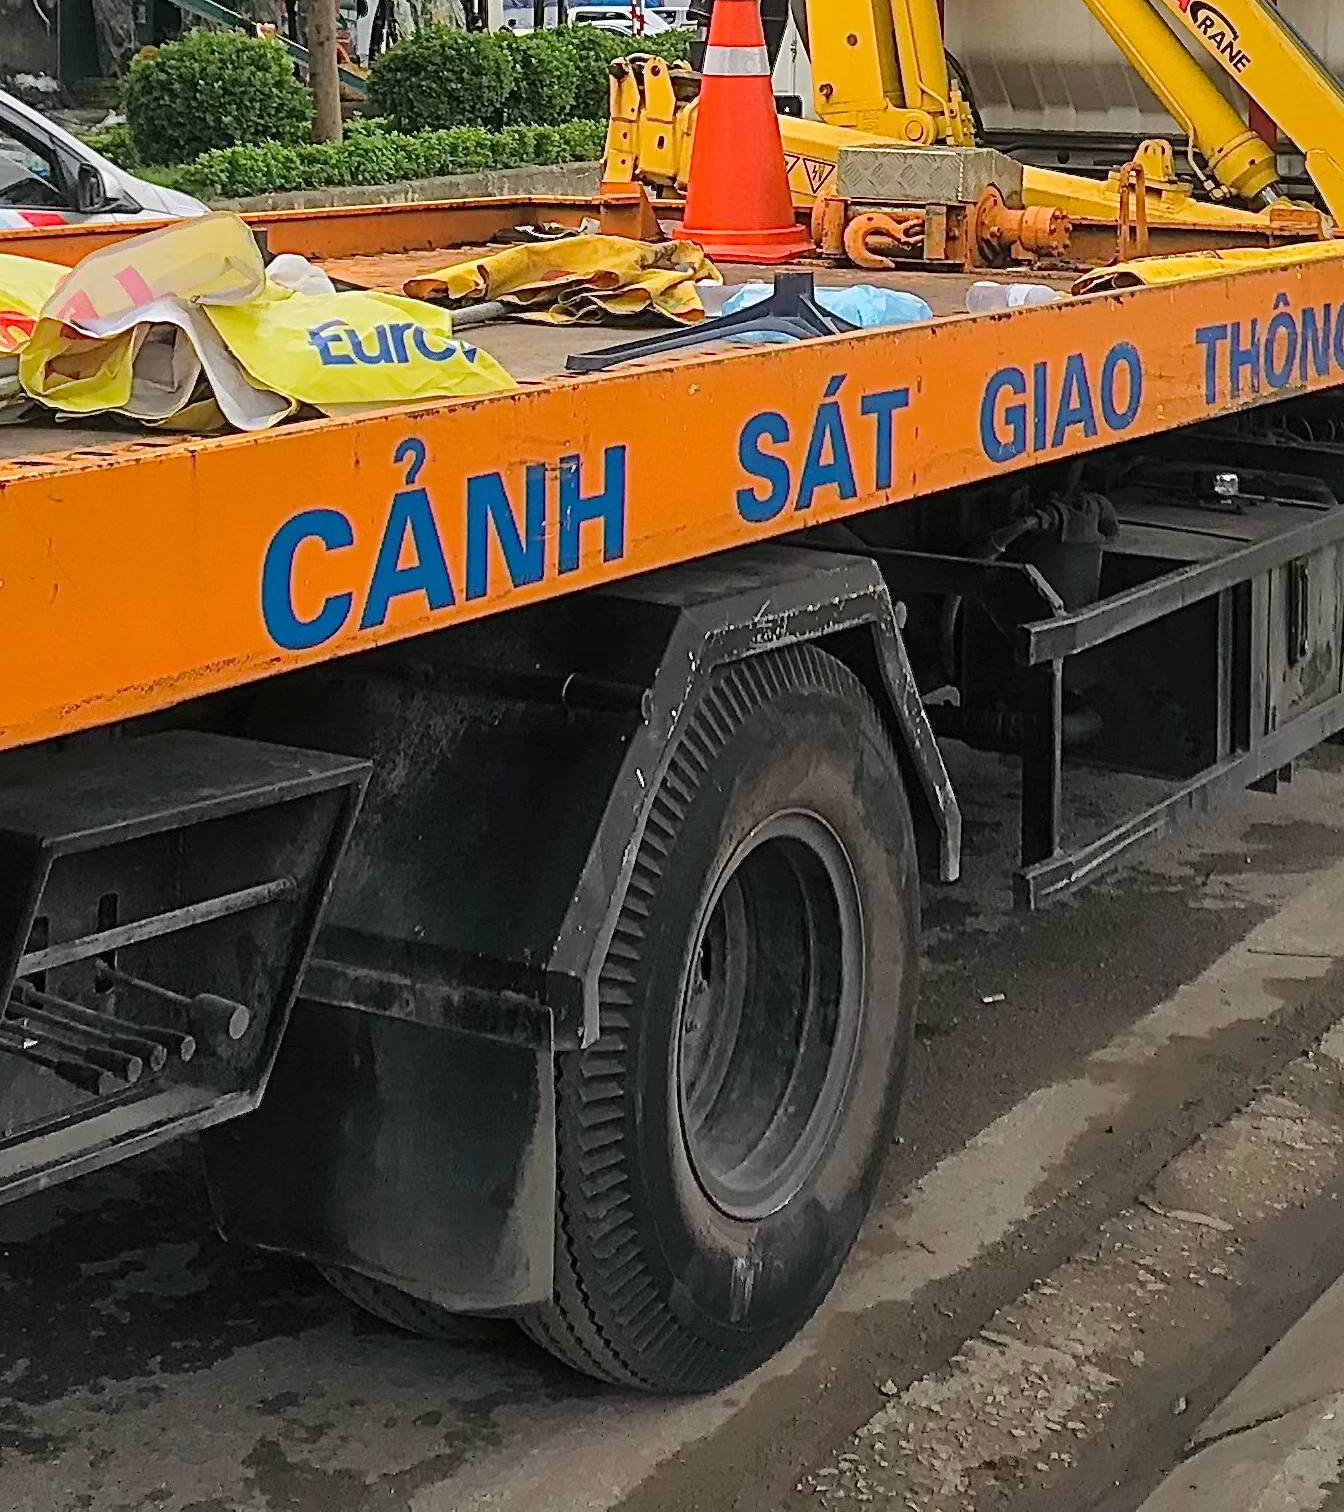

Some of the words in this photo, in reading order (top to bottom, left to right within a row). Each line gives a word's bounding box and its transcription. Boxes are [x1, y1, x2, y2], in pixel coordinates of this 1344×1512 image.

[1190, 0, 1251, 73] CRANE
[261, 437, 626, 650] CẢNH
[734, 375, 909, 523] SÁT
[979, 341, 1143, 463] GIAO
